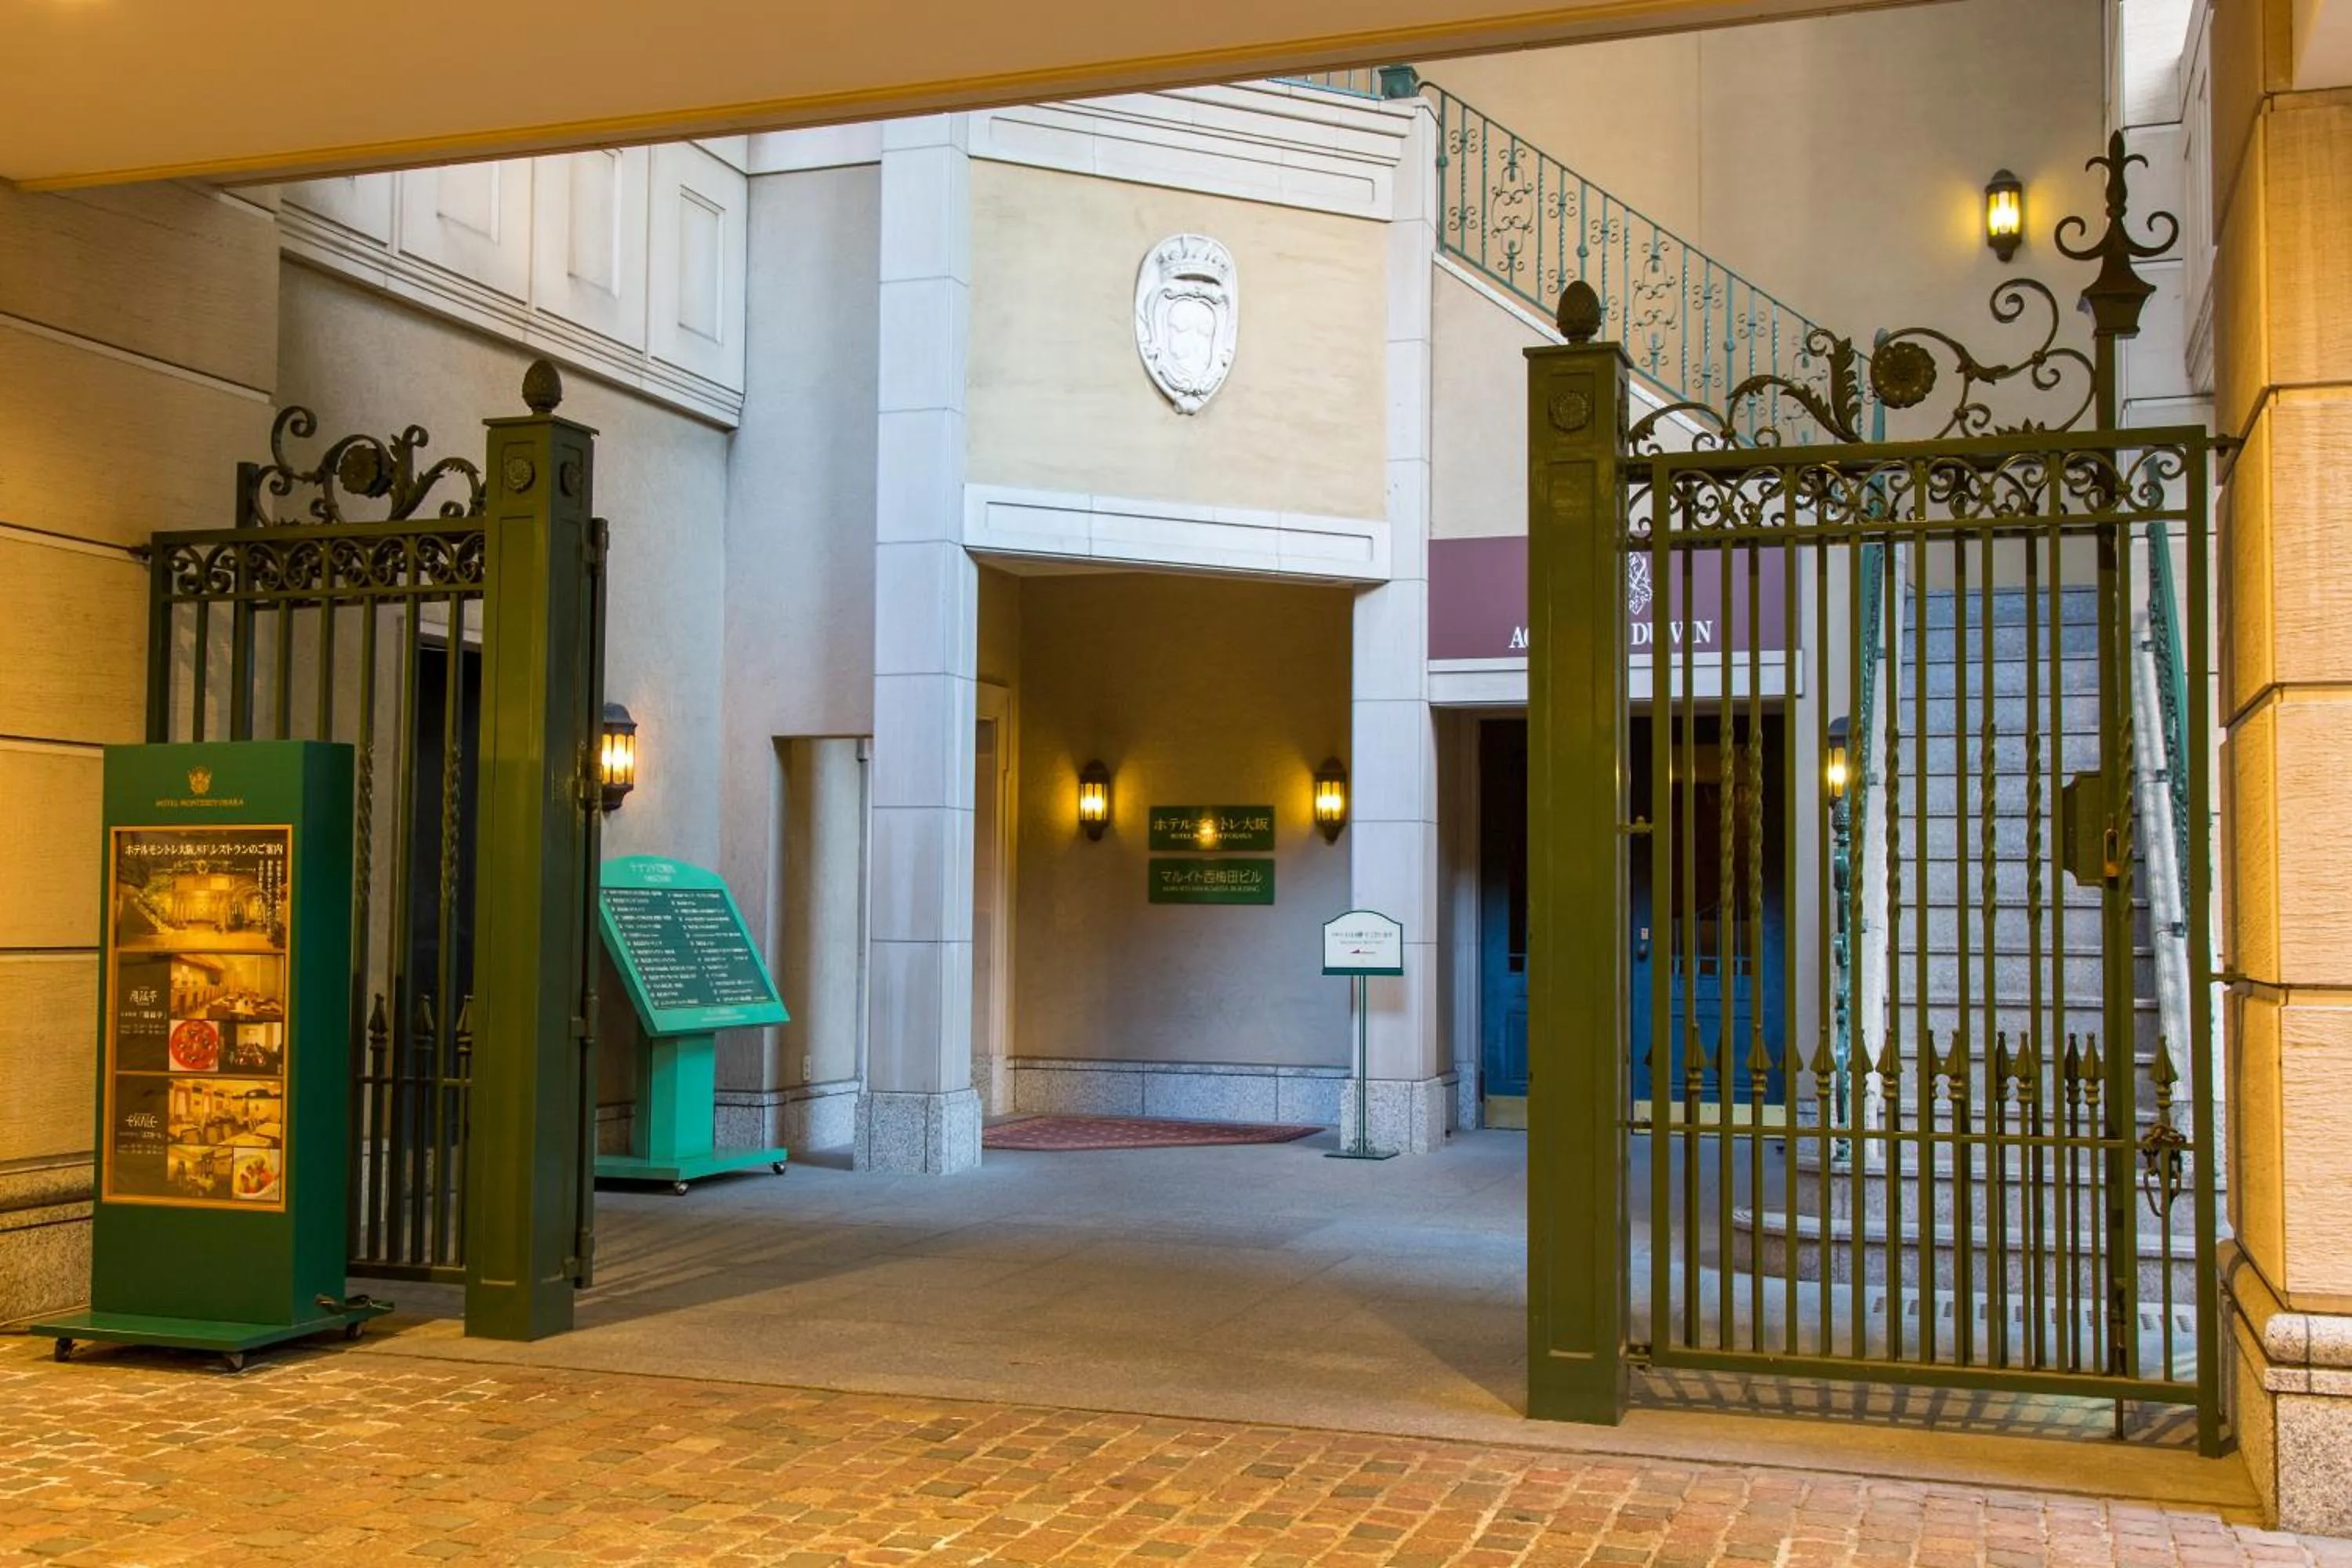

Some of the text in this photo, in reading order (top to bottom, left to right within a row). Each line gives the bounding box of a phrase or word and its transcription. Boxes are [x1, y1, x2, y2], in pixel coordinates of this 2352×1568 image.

[1670, 620, 1713, 645] VN
[1153, 817, 1269, 831] ホテルトレ大阪
